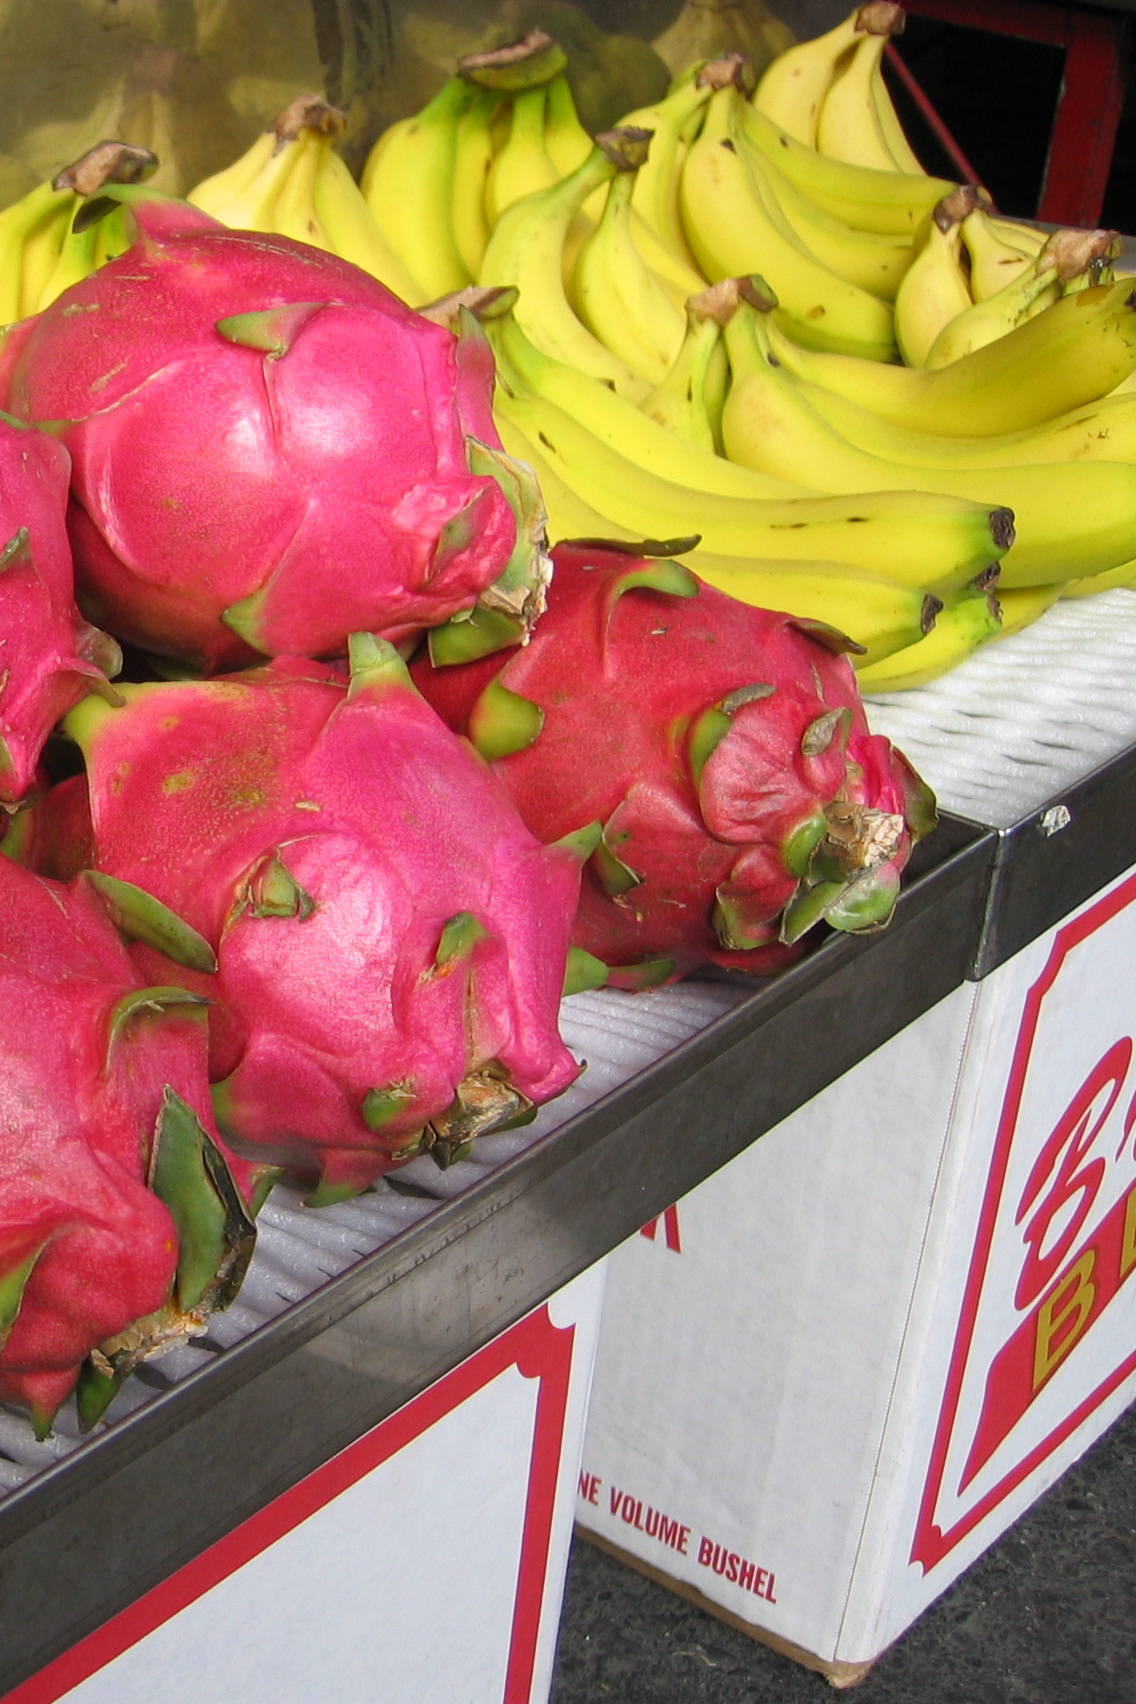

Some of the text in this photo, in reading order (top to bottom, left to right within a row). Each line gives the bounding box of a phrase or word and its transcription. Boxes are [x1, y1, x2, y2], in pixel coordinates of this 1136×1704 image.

[577, 1469, 776, 1604] NE VOLUME BUSHEL
